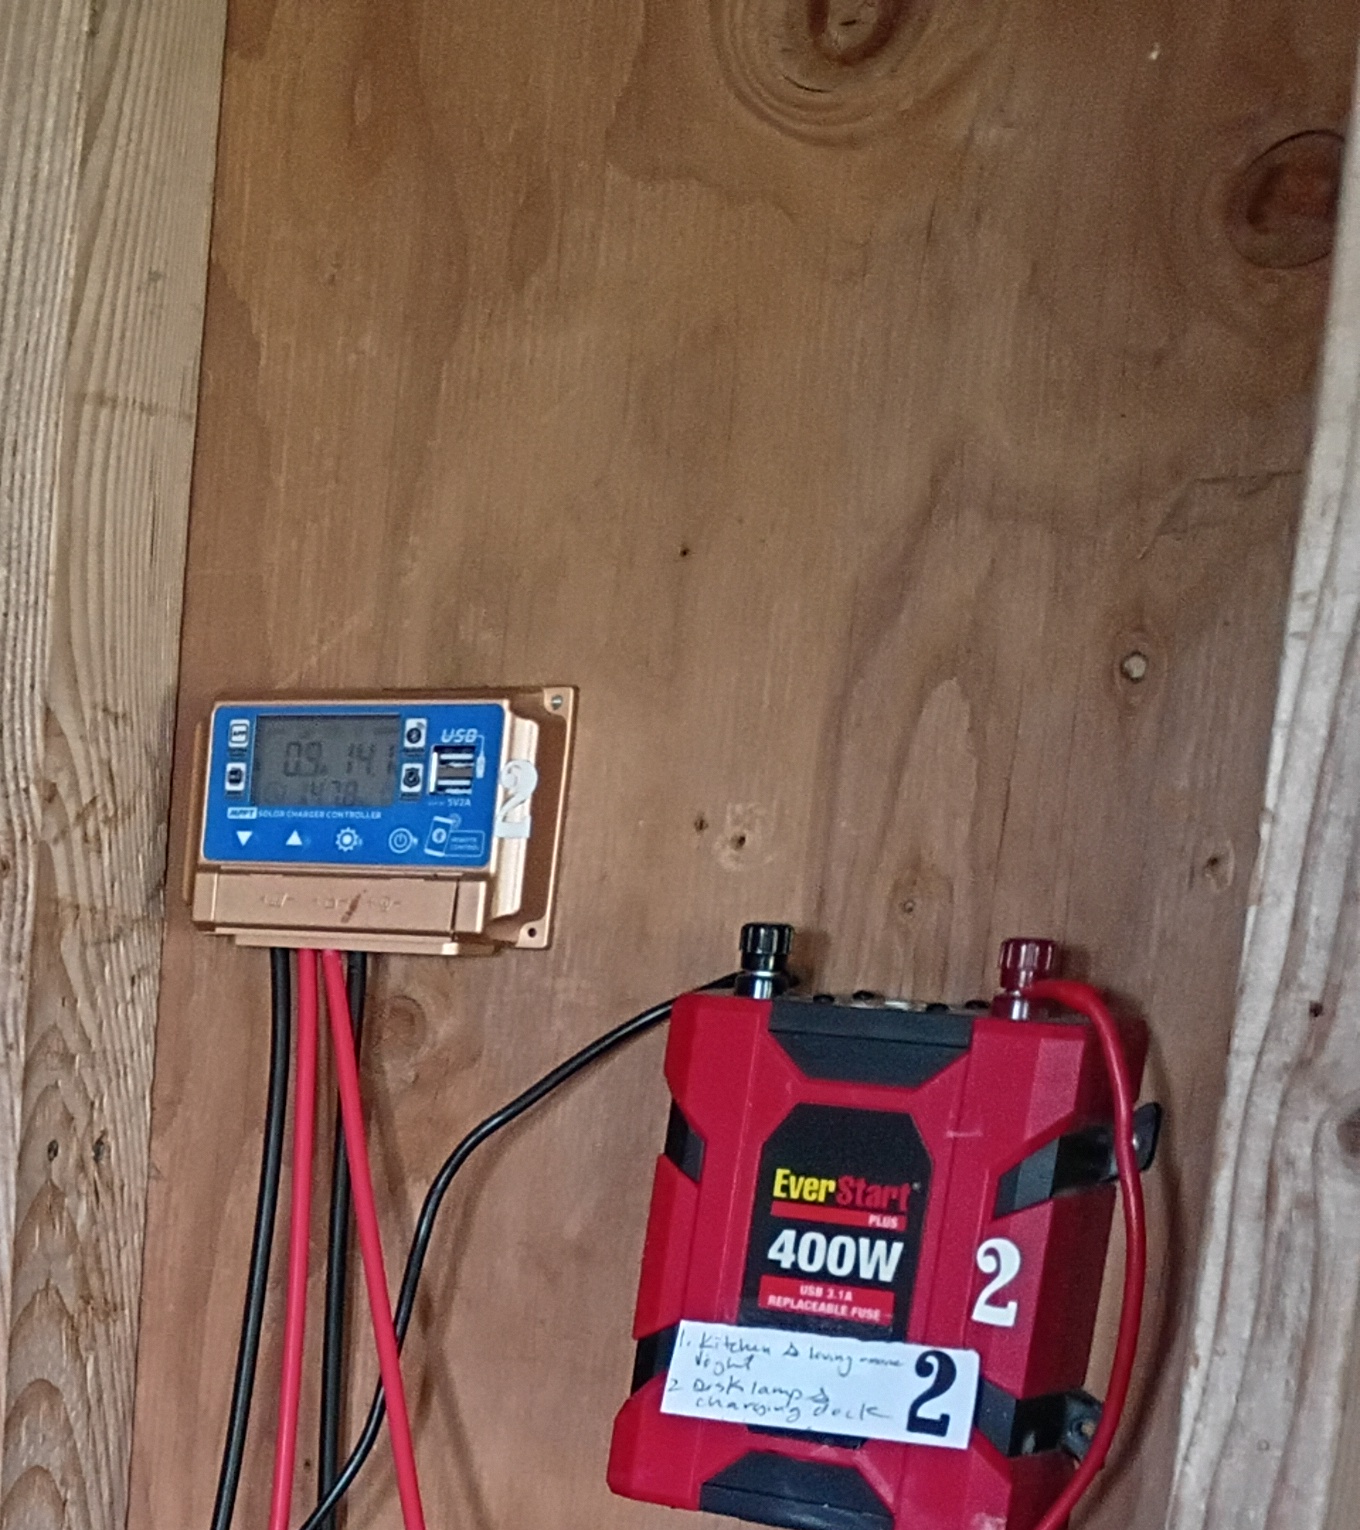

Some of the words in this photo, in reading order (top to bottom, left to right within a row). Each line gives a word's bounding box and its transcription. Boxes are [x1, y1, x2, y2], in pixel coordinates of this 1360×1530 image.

[440, 728, 479, 743] USB
[326, 810, 381, 819] CONTROLLER
[494, 759, 538, 839] 2
[772, 1168, 911, 1212] EverStart
[867, 1214, 898, 1229] PLUS
[767, 1229, 905, 1283] 400W
[799, 1284, 824, 1298] USB
[827, 1288, 853, 1302] 3.1A
[971, 1237, 1022, 1327] 2
[767, 1295, 849, 1318] REPLACEABLE
[850, 1306, 881, 1321] FUSE
[905, 1349, 958, 1438] 2
